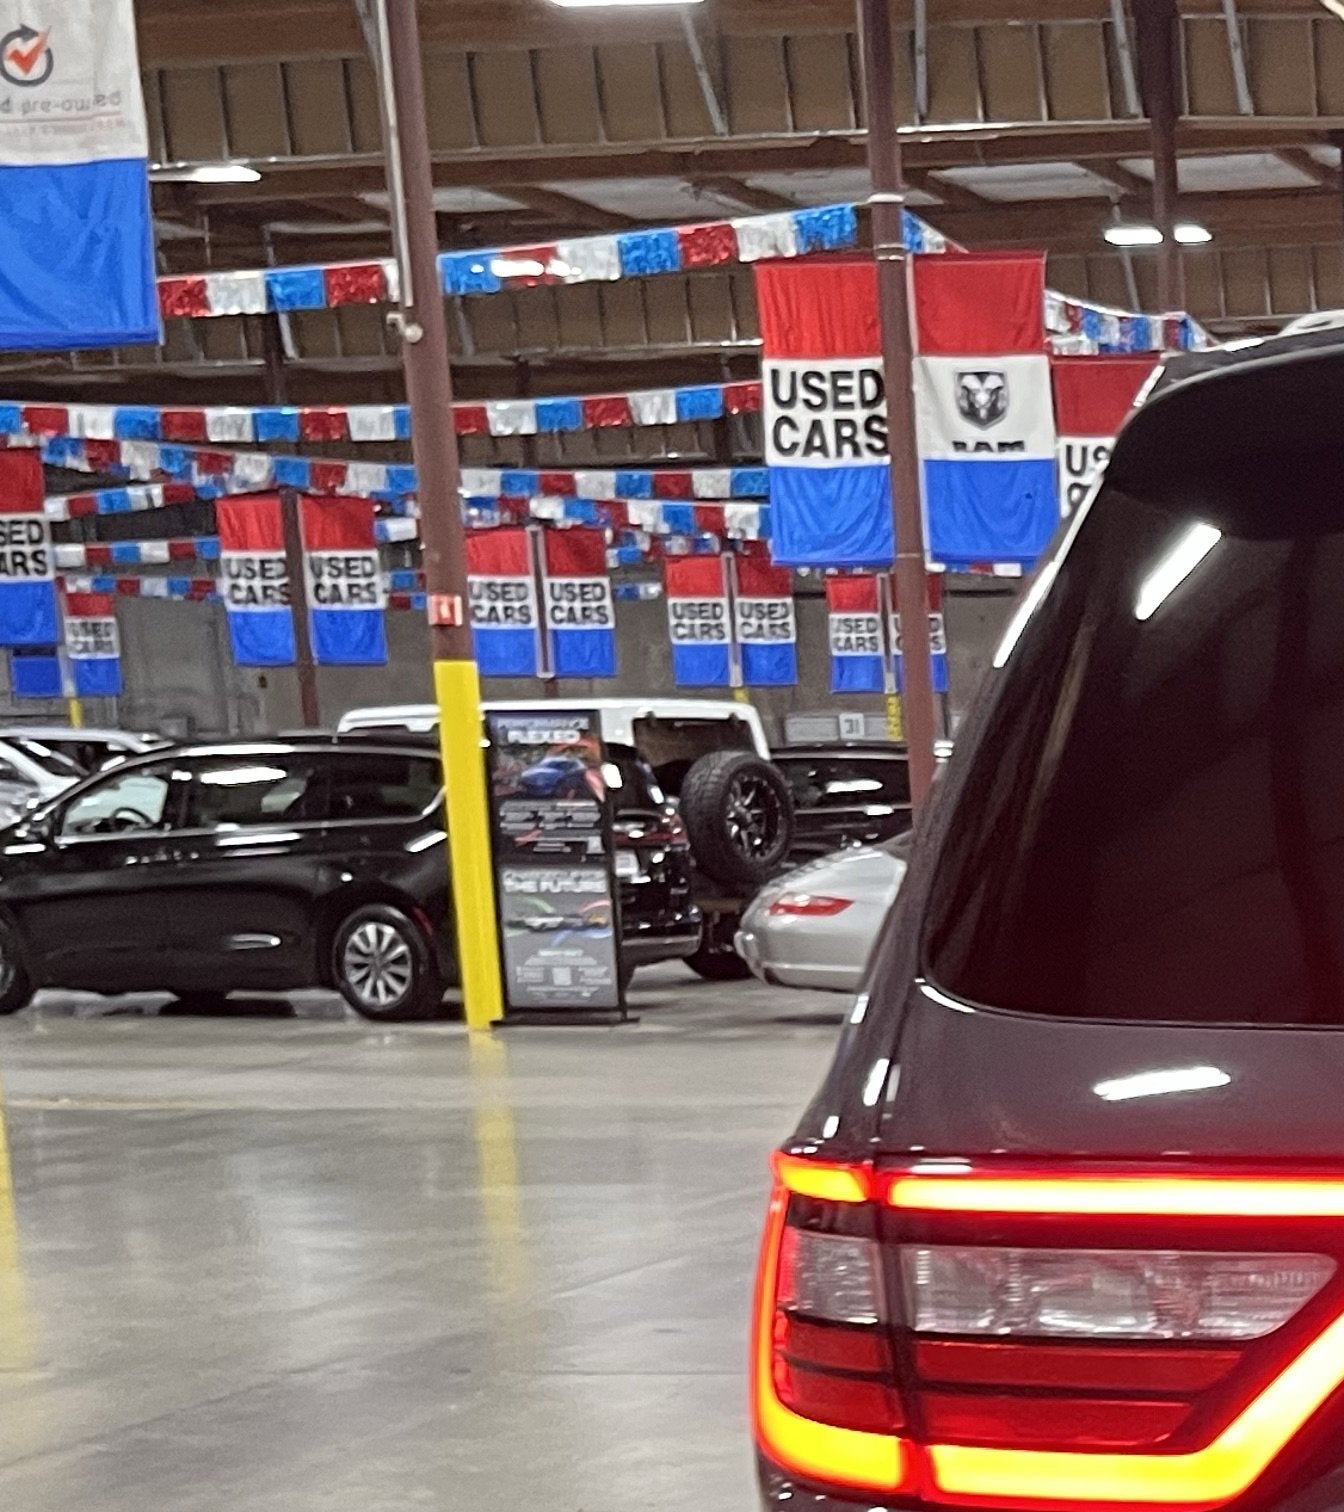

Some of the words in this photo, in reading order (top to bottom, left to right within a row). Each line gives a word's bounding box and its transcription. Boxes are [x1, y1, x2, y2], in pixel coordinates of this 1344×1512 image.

[771, 368, 885, 412] USED
[773, 414, 889, 458] CARS
[0, 550, 47, 576] ARS
[226, 557, 287, 580] USED
[310, 556, 376, 579] USED
[230, 583, 291, 605] CARS
[313, 582, 377, 604] CARS
[470, 581, 529, 601] USED
[550, 582, 606, 602] USED
[472, 604, 532, 624] CARS
[551, 604, 609, 624] CARS
[672, 602, 724, 620] USED
[740, 602, 789, 620] USED
[673, 622, 725, 640] CARS
[741, 621, 791, 640] CARS
